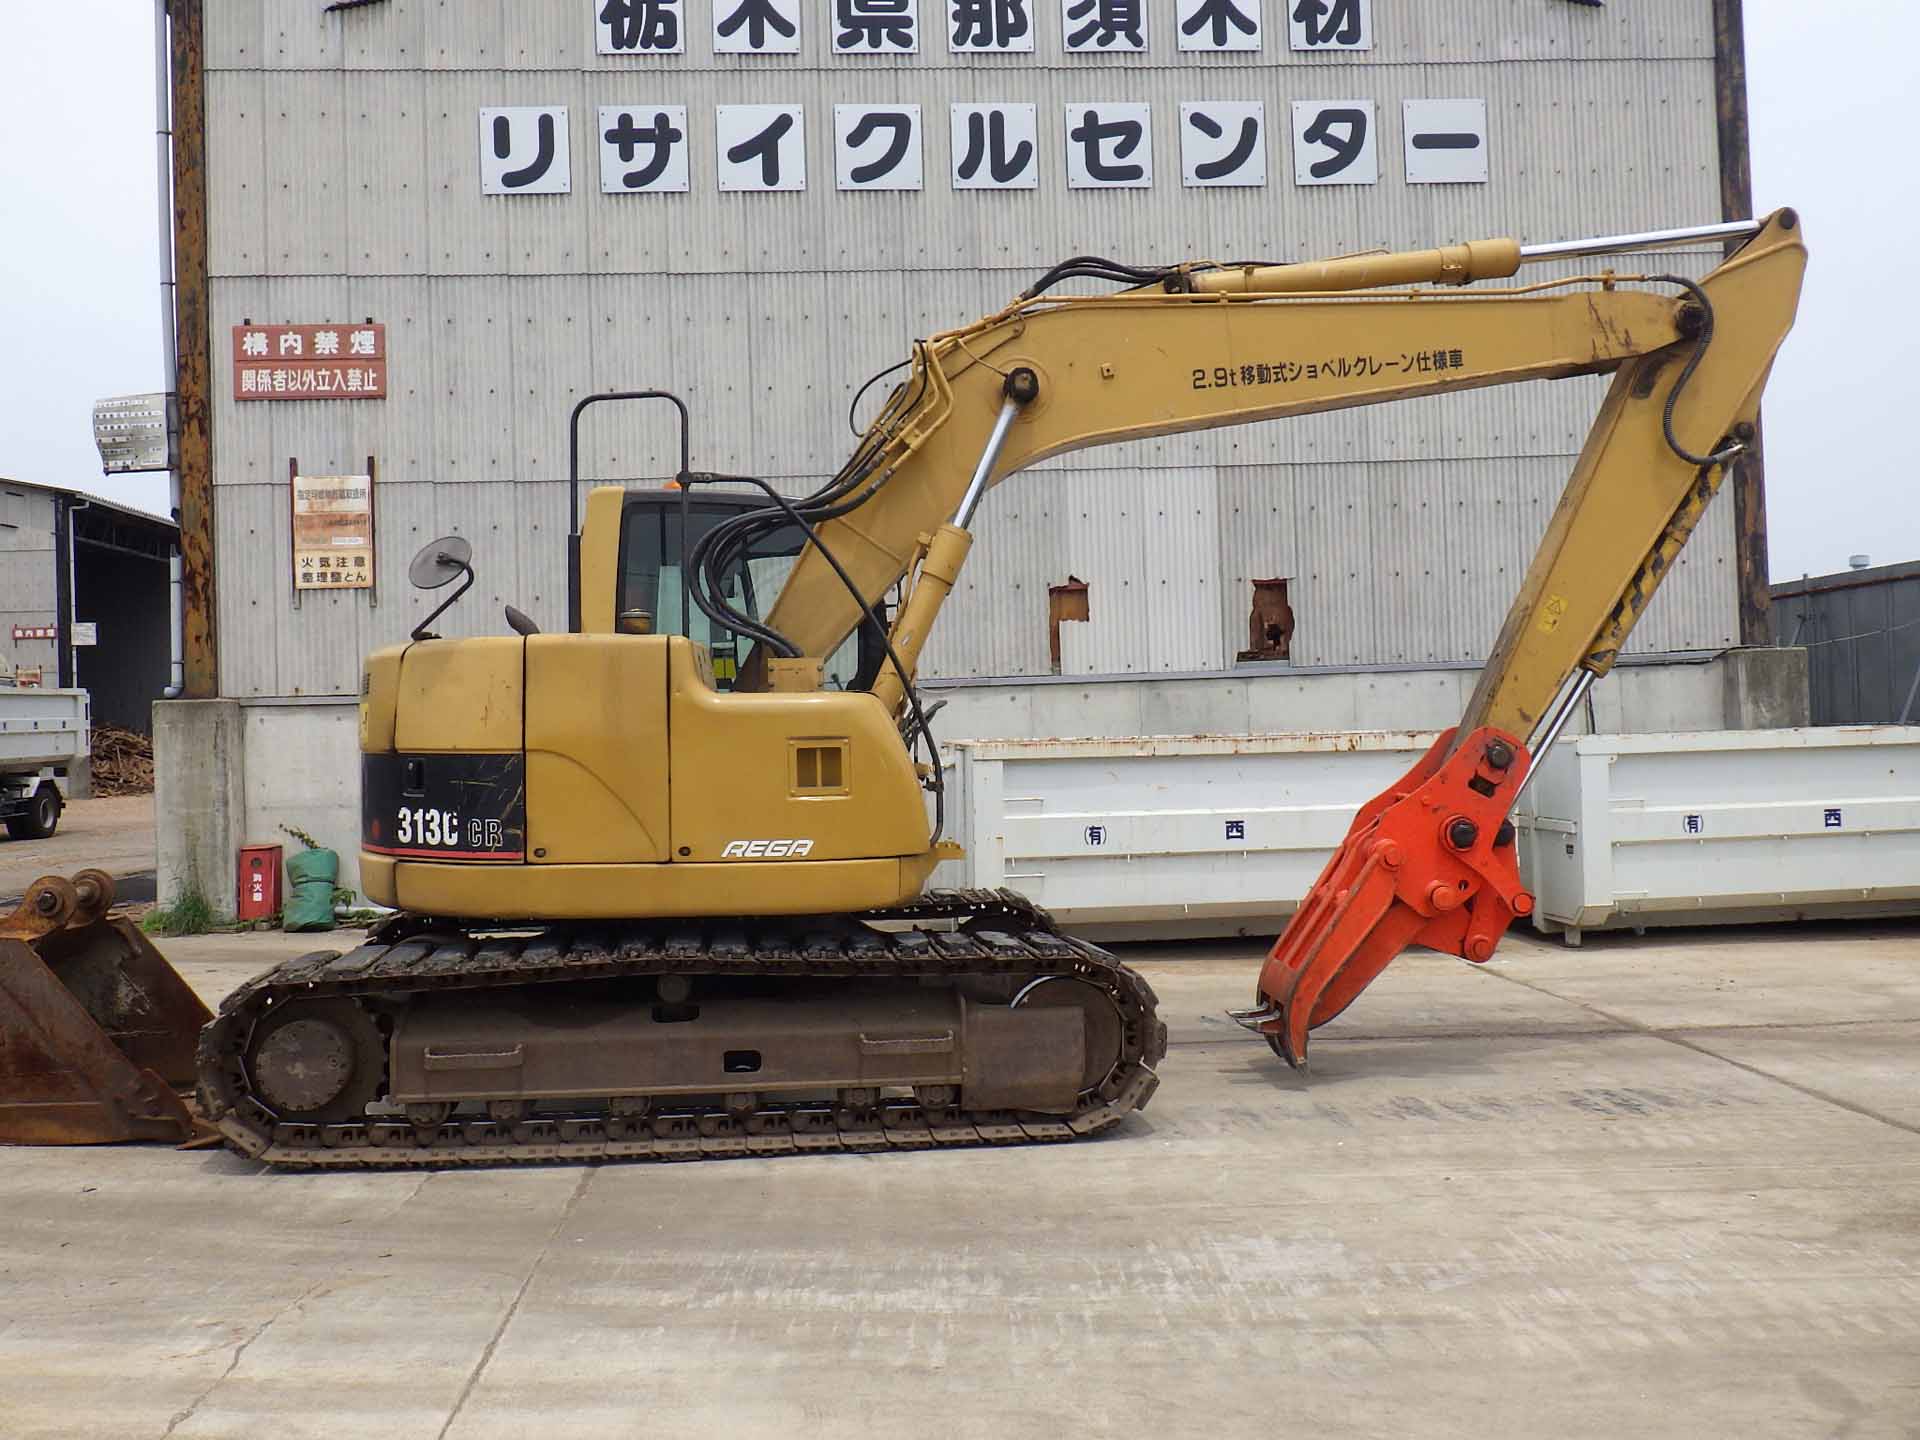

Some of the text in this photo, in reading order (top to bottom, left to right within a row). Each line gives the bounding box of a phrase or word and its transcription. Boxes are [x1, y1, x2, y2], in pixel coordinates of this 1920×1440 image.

[493, 109, 1480, 188] リサイクルセンター
[242, 330, 375, 355] 構内禁煙
[241, 368, 377, 391] 関係者以外立入禁止
[398, 806, 503, 847] 313C CR
[1824, 808, 1842, 827] 西
[1225, 820, 1244, 840] 西
[721, 839, 815, 858] REGA
